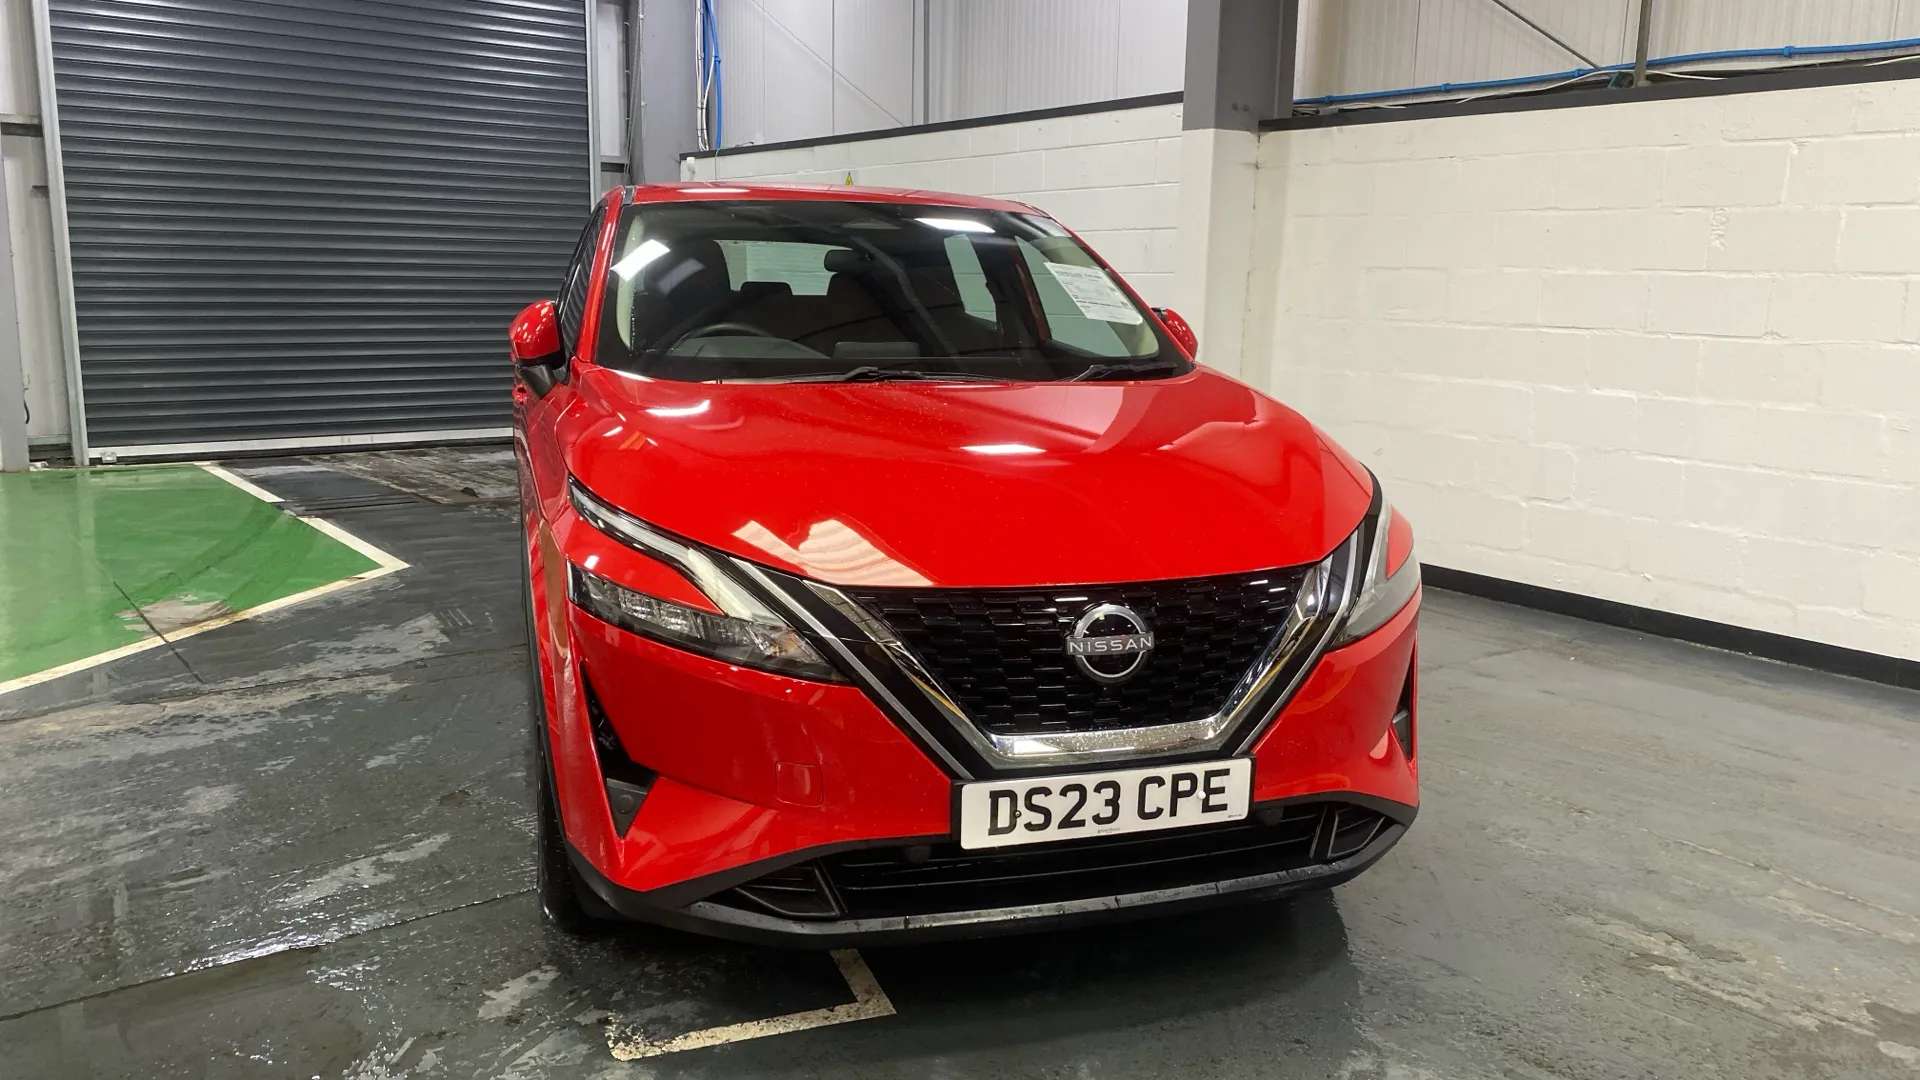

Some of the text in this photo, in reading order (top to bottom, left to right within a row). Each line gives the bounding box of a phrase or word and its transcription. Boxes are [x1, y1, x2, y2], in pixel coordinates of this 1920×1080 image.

[1069, 636, 1152, 653] NISSAN
[988, 768, 1231, 836] DS23 CPE
